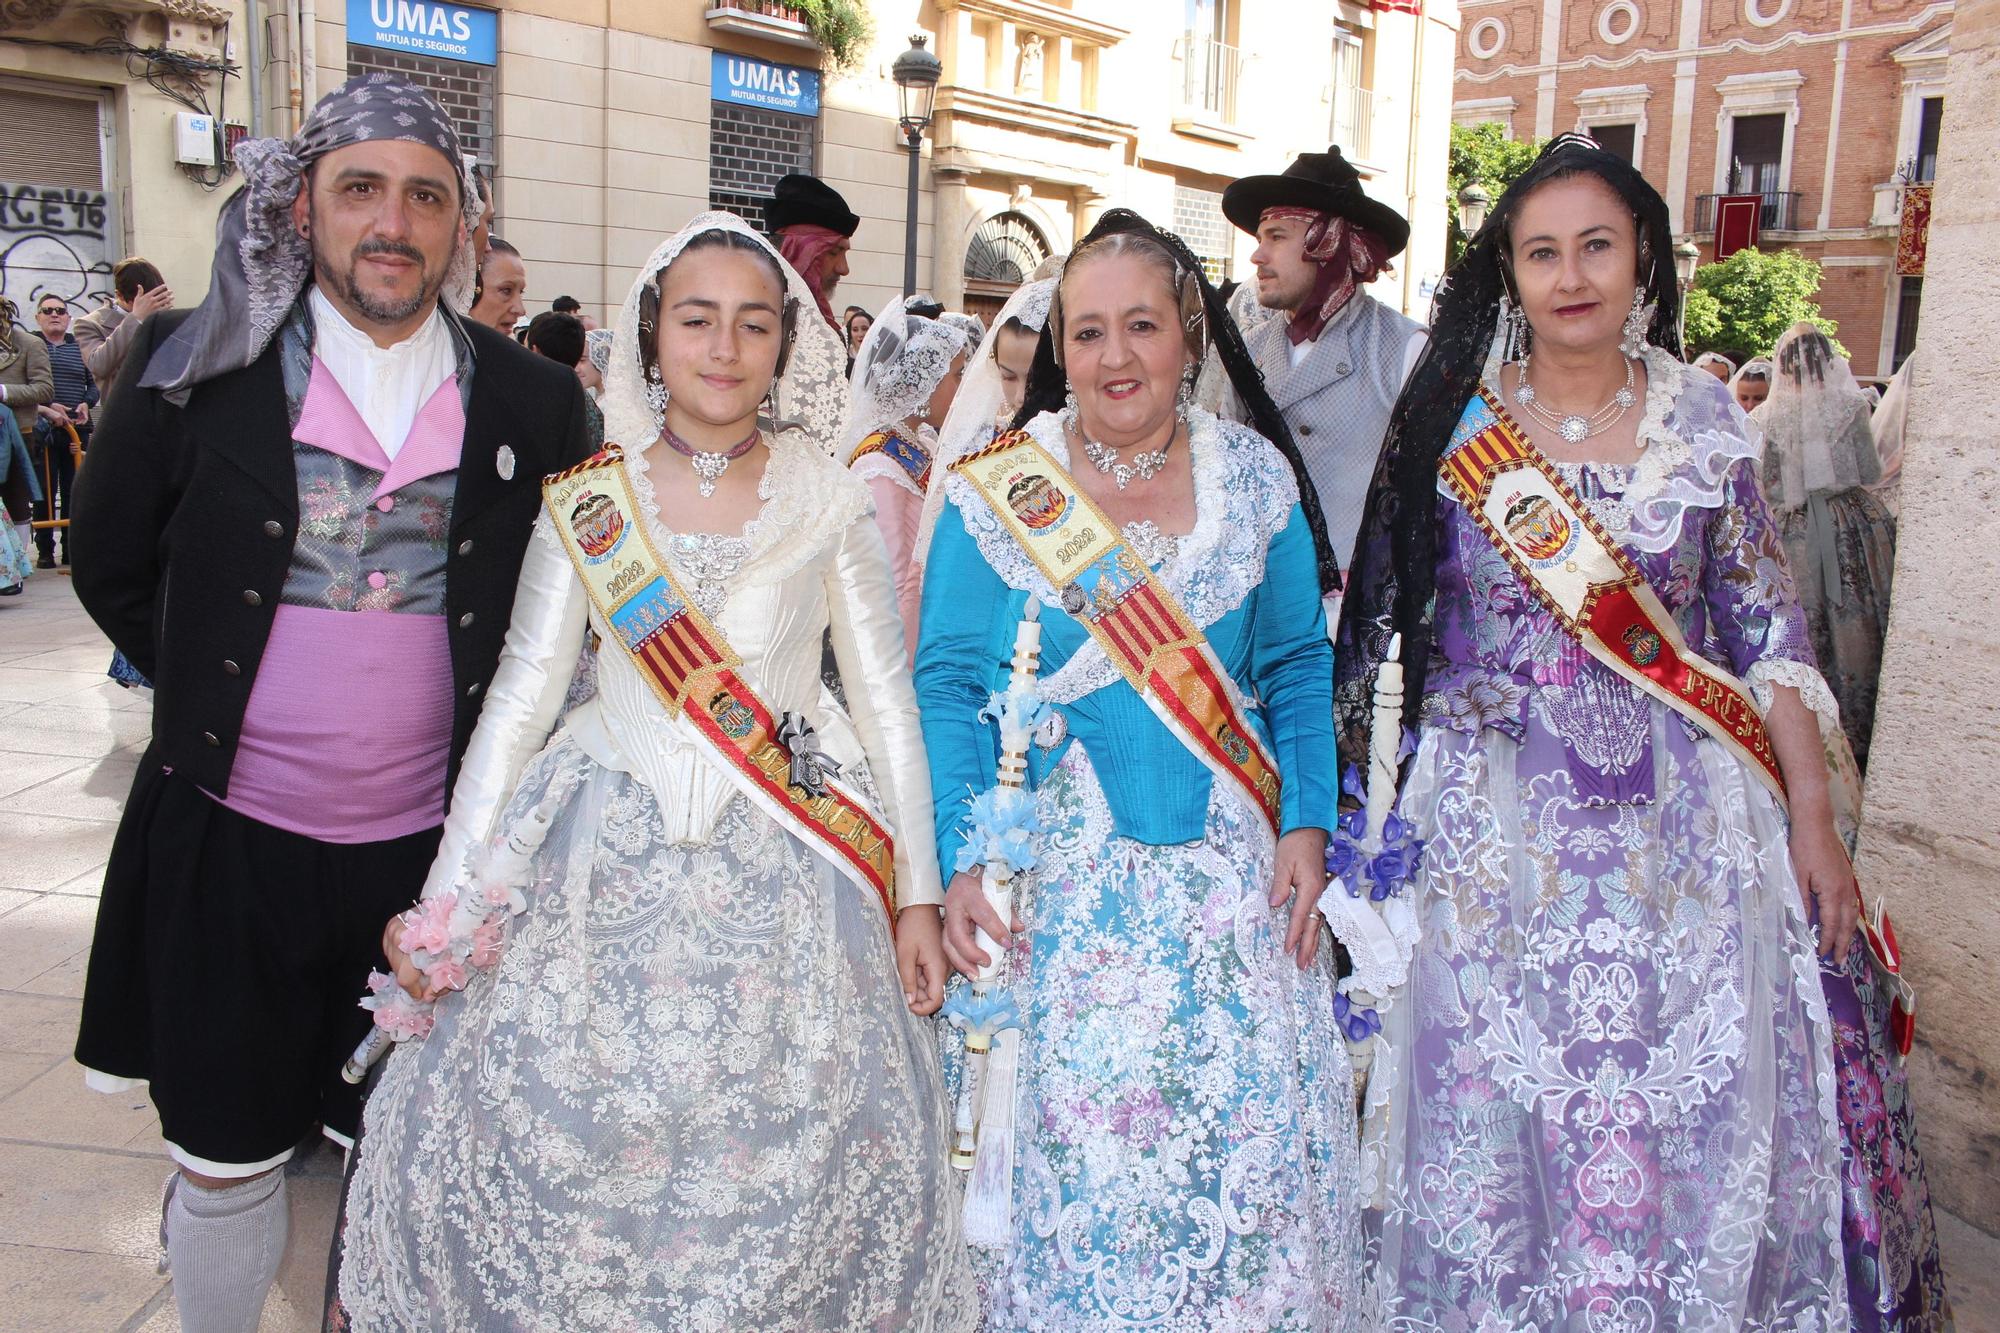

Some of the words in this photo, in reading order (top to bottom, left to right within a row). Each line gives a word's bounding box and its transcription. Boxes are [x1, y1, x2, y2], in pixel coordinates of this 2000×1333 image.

[371, 0, 471, 41] UMAS
[376, 32, 410, 46] MUTUA
[411, 37, 424, 48] DE
[425, 40, 468, 55] SEGUROS
[728, 59, 801, 97] UMAS
[731, 89, 757, 101] MUTUA
[757, 94, 766, 103] DE
[766, 95, 797, 108] SEGUROS
[1008, 472, 1024, 486] FALLA
[576, 490, 592, 504] FALLA
[1505, 490, 1522, 508] FALLA
[1056, 527, 1096, 565] 2022
[607, 560, 645, 599] 2022
